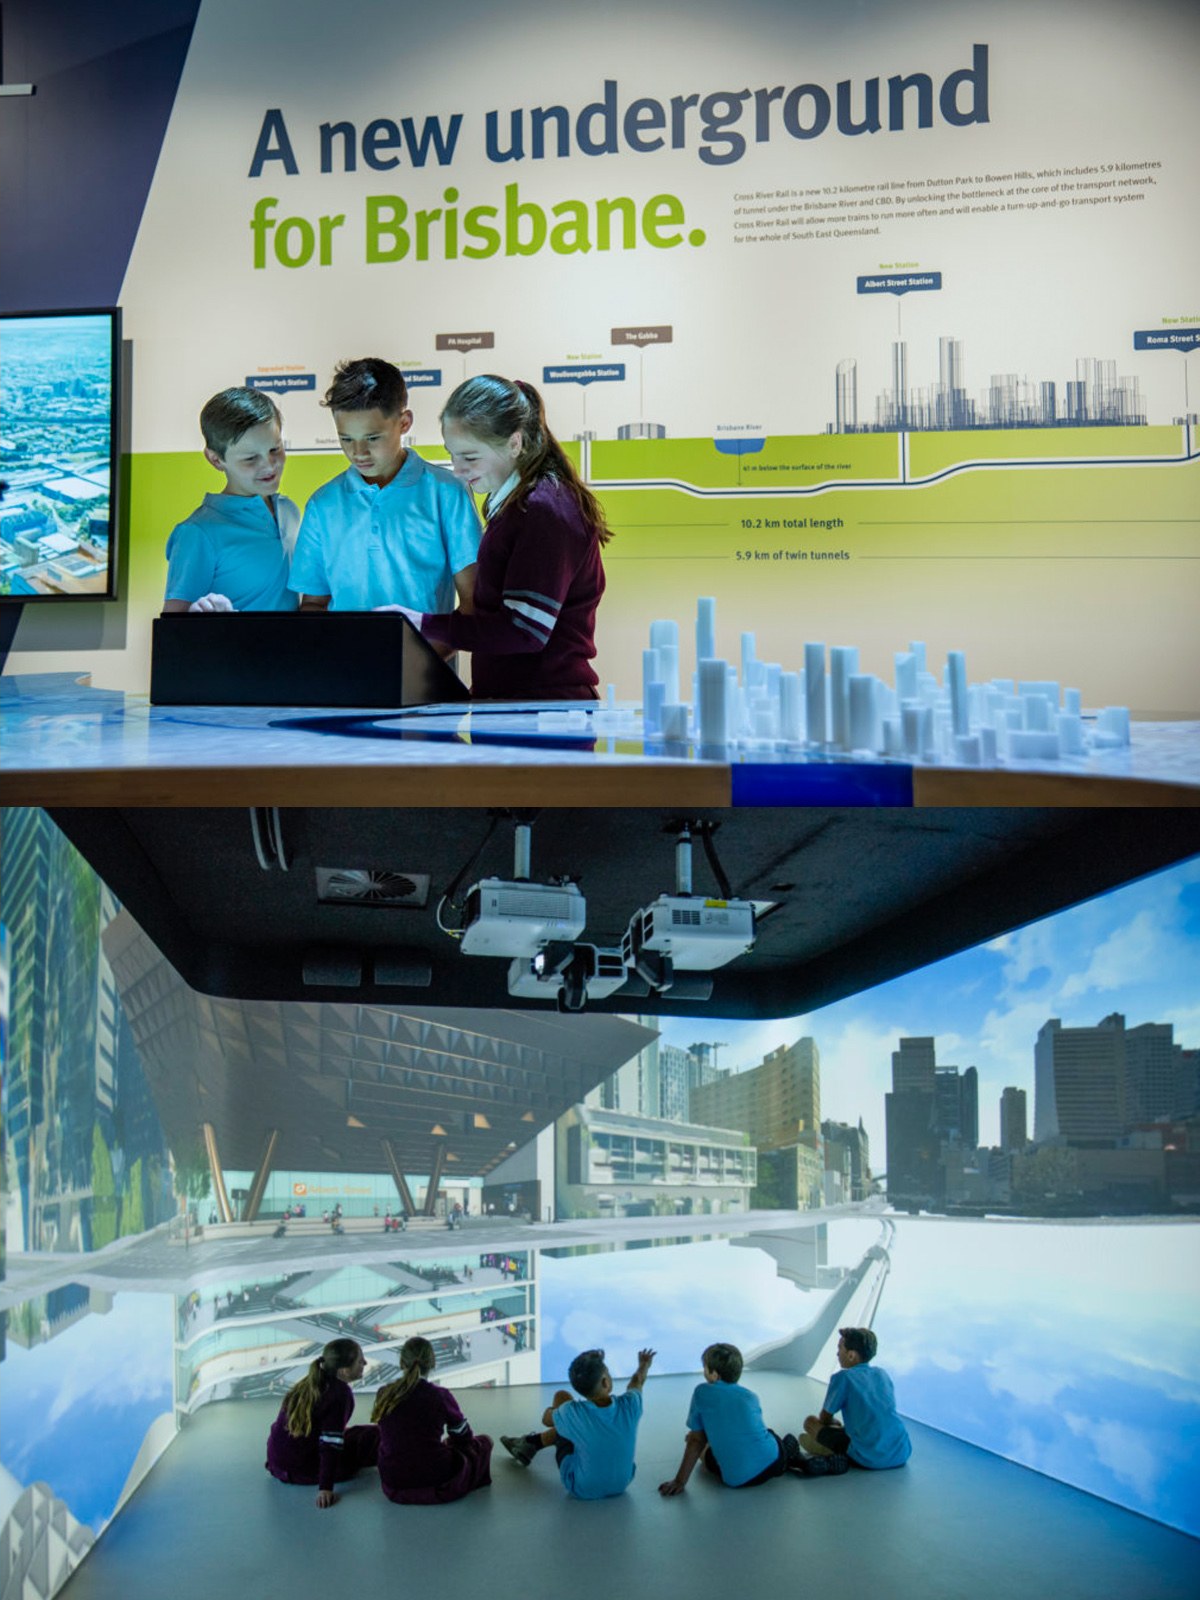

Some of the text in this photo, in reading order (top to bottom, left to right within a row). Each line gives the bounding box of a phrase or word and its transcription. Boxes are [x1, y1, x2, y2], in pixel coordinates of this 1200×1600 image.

[248, 43, 991, 177] A new underground
[734, 193, 754, 201] Cross
[755, 192, 774, 200] River
[775, 190, 789, 198] Rail
[823, 187, 838, 195] 10.2
[839, 184, 876, 193] kilometre
[877, 182, 889, 191] rail
[890, 181, 905, 190] line
[906, 179, 925, 188] from
[926, 178, 954, 187] Dutton
[955, 176, 973, 185] Park
[985, 174, 1013, 183] Bowen
[1014, 171, 1035, 181] Hills,
[1036, 169, 1062, 178] which
[1063, 166, 1099, 176] includes
[1100, 165, 1113, 173] 5.9
[1115, 160, 1162, 171] kilometres
[743, 206, 766, 214] tunnel
[768, 204, 788, 213] under
[790, 203, 802, 211] the
[804, 201, 837, 211] Brisbane
[839, 200, 858, 208] River
[859, 198, 874, 207] and
[875, 196, 892, 206] CBD.
[895, 196, 906, 206] By
[907, 193, 945, 204] unlocking
[947, 192, 960, 200] the
[962, 188, 1004, 199] bottleneck
[1006, 188, 1015, 196] at
[1016, 186, 1030, 195] the
[1031, 186, 1049, 194] core
[1050, 184, 1059, 192] of
[1061, 182, 1075, 191] the
[1076, 179, 1116, 191] transport
[1117, 176, 1157, 187] network,
[734, 221, 754, 229] Cross
[755, 219, 774, 228] River
[776, 218, 790, 226] Rail
[791, 217, 804, 225] will
[805, 216, 825, 224] allow
[827, 215, 846, 223] more
[847, 213, 870, 221] trains
[871, 212, 879, 220] to
[895, 210, 915, 218] more
[917, 207, 937, 217] often
[939, 206, 954, 215] and
[955, 206, 970, 214] will
[971, 203, 999, 213] enable
[1007, 199, 1070, 212] turn-up-and-go
[1072, 195, 1111, 206] transport
[1113, 192, 1145, 204] system
[250, 182, 707, 269] for Brisbane.
[734, 226, 882, 243] for the whole of South East Queensland.
[865, 276, 934, 288] Albert Street Station
[625, 332, 637, 340] The
[1146, 336, 1168, 344] Roma
[1170, 334, 1194, 344] Street
[413, 374, 434, 382] Station
[597, 368, 620, 377] Station
[287, 378, 309, 387] Station
[746, 423, 762, 431] River
[779, 463, 790, 471] the
[791, 463, 815, 471] surface
[825, 462, 835, 470] the
[741, 517, 844, 530] 10.2 km total length
[735, 549, 850, 560] 5.9 km of twin tunnels
